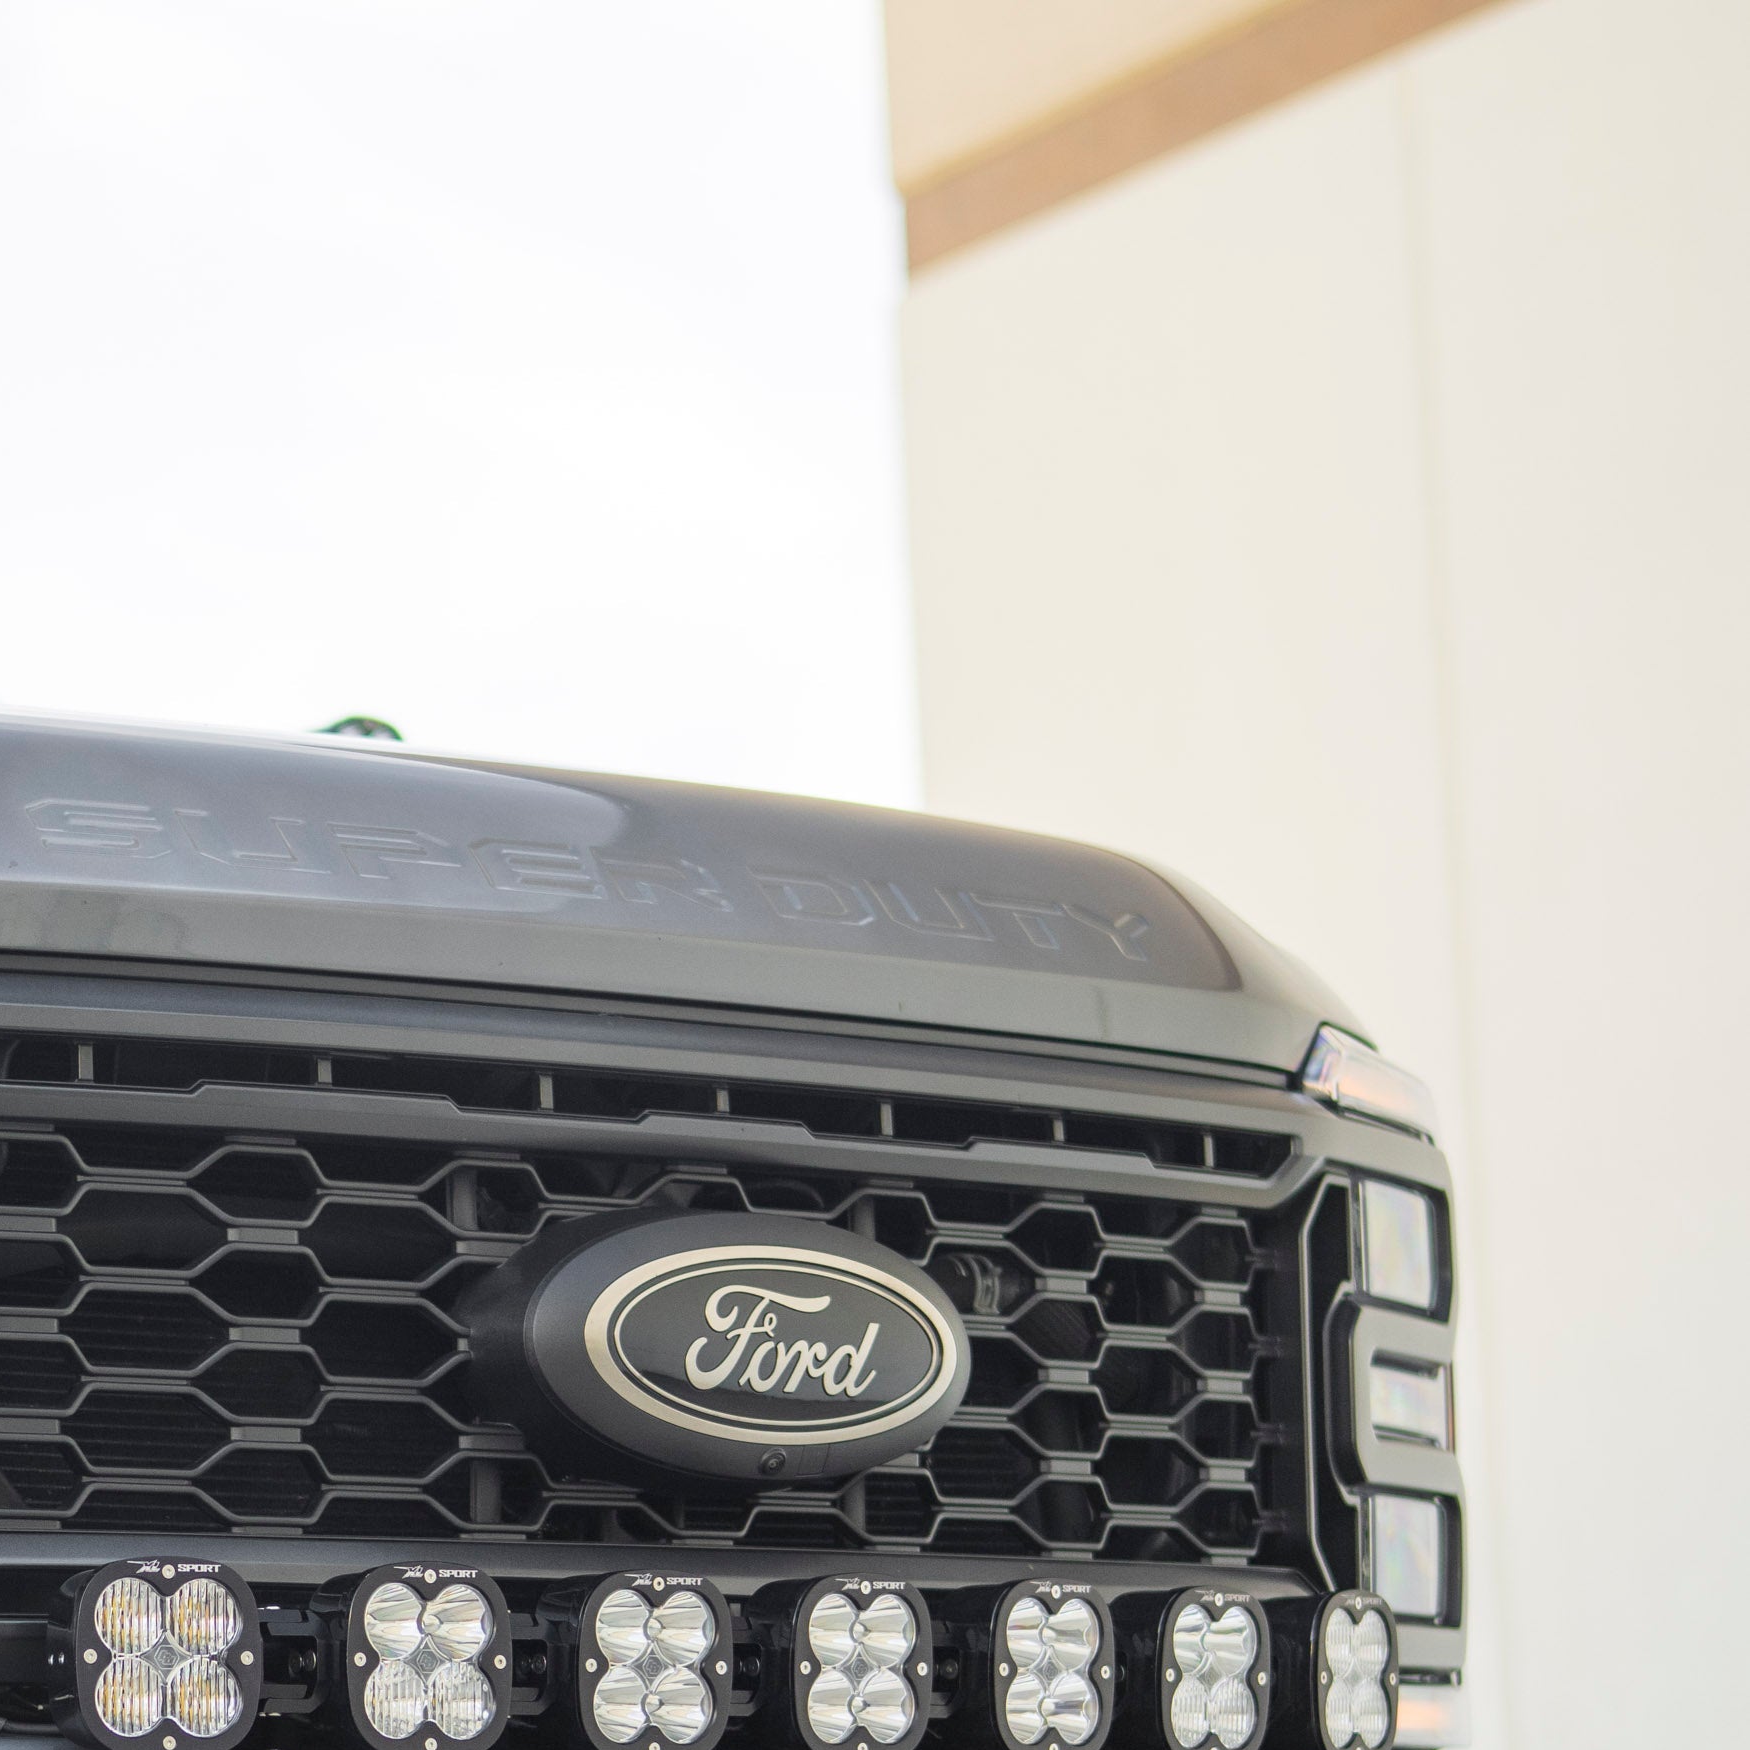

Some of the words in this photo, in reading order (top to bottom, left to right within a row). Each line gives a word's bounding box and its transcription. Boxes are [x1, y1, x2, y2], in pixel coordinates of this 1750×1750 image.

[25, 799, 734, 912] SUPER
[747, 866, 1148, 962] DUTY
[685, 1284, 881, 1397] Ford
[177, 1563, 222, 1573] SPORT
[438, 1569, 479, 1578] SPORT
[666, 1577, 704, 1586] SPORT
[872, 1581, 906, 1590] SPORT
[1062, 1584, 1092, 1593] SPORT
[1224, 1593, 1251, 1603] SPORT
